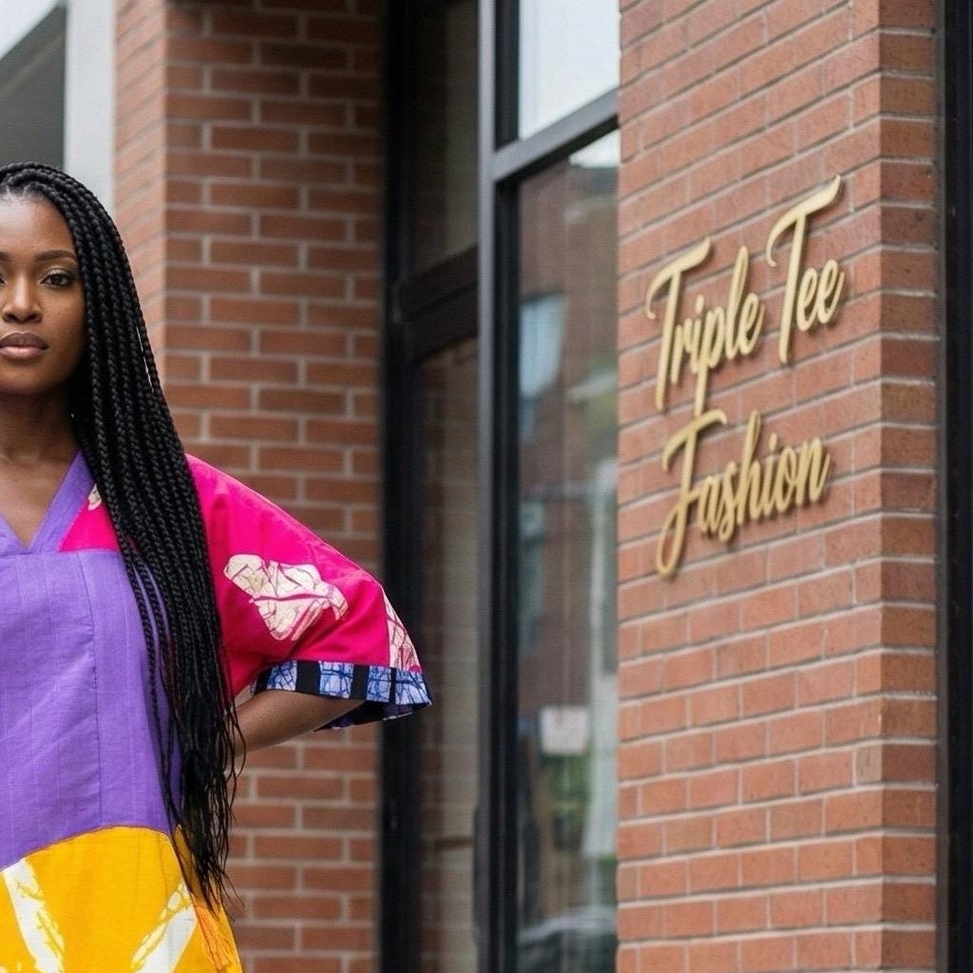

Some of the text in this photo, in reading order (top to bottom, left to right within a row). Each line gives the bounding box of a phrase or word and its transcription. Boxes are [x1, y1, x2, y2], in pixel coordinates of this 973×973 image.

[645, 174, 845, 415] Triple Tee
[656, 409, 830, 577] Fashion
